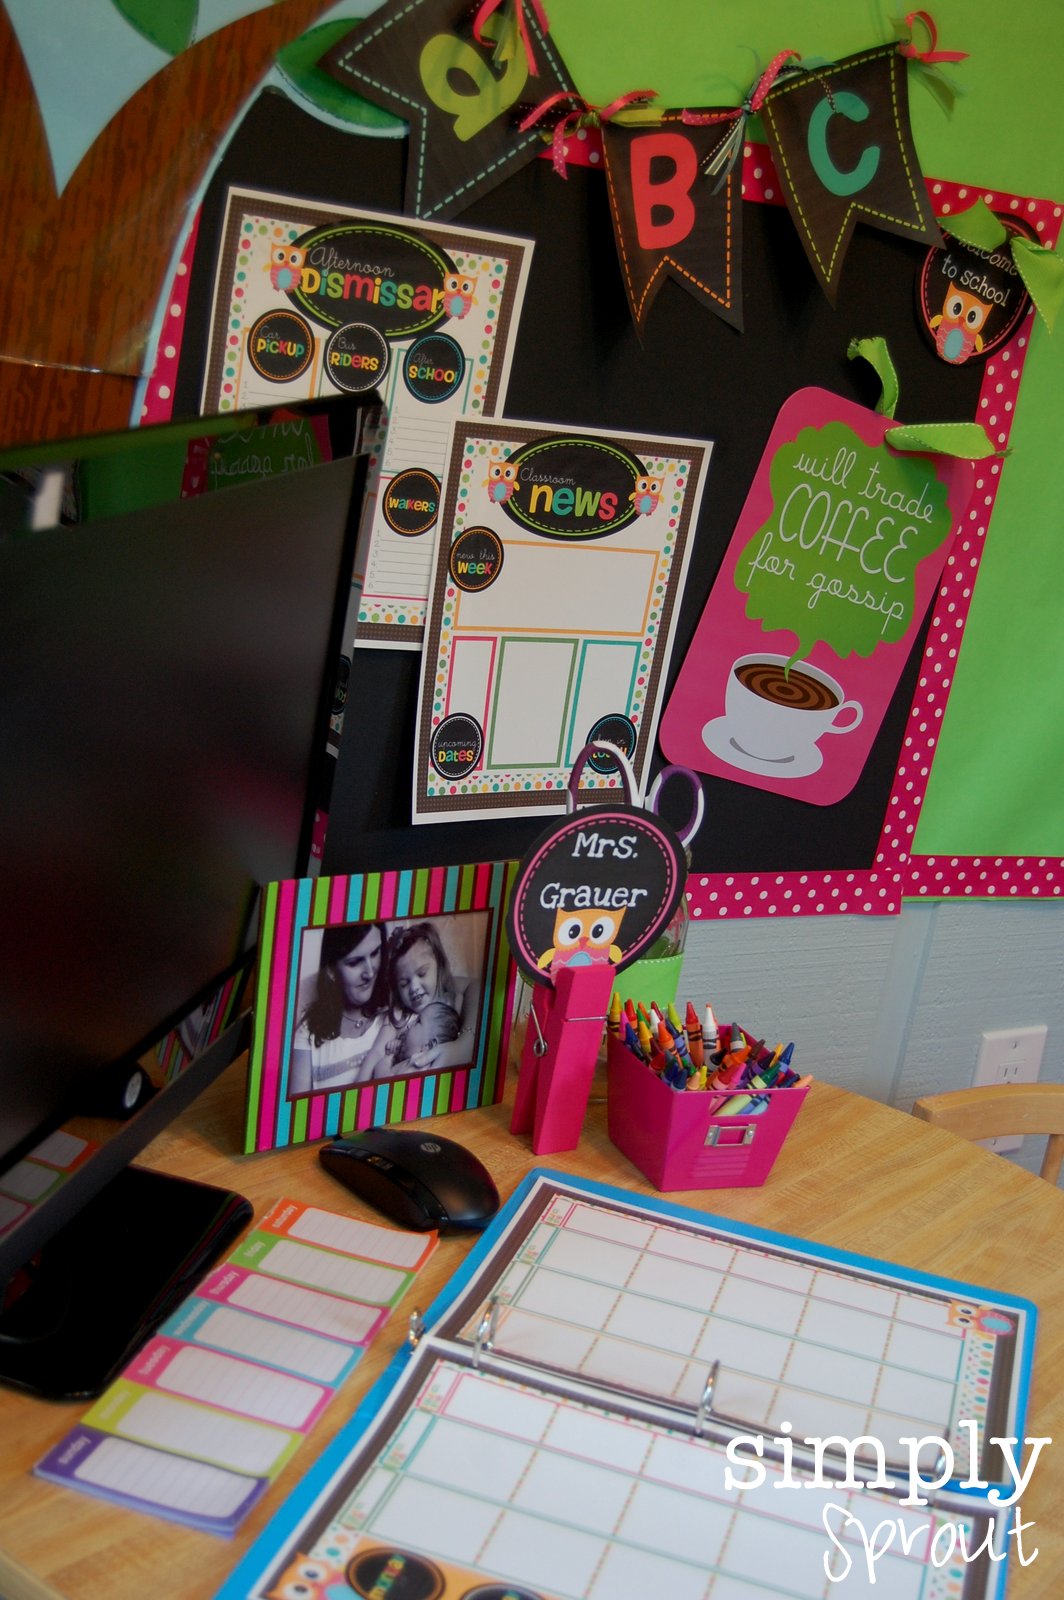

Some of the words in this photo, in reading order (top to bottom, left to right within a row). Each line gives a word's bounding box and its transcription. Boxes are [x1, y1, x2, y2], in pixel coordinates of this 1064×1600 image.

[630, 133, 698, 250] B
[807, 91, 881, 196] C
[309, 246, 395, 278] Afternoon
[941, 254, 958, 279] to
[960, 270, 1011, 307] school
[260, 325, 281, 339] Car
[337, 336, 357, 350] Bus
[520, 466, 576, 486] Classroom
[793, 447, 857, 489] will
[858, 461, 933, 523] trade
[529, 484, 618, 520] news
[479, 548, 496, 561] this
[746, 531, 795, 588] for
[806, 572, 905, 635] gossip
[437, 741, 478, 750] upcoming
[571, 832, 639, 859] Mrs.
[539, 882, 648, 909] Grauer
